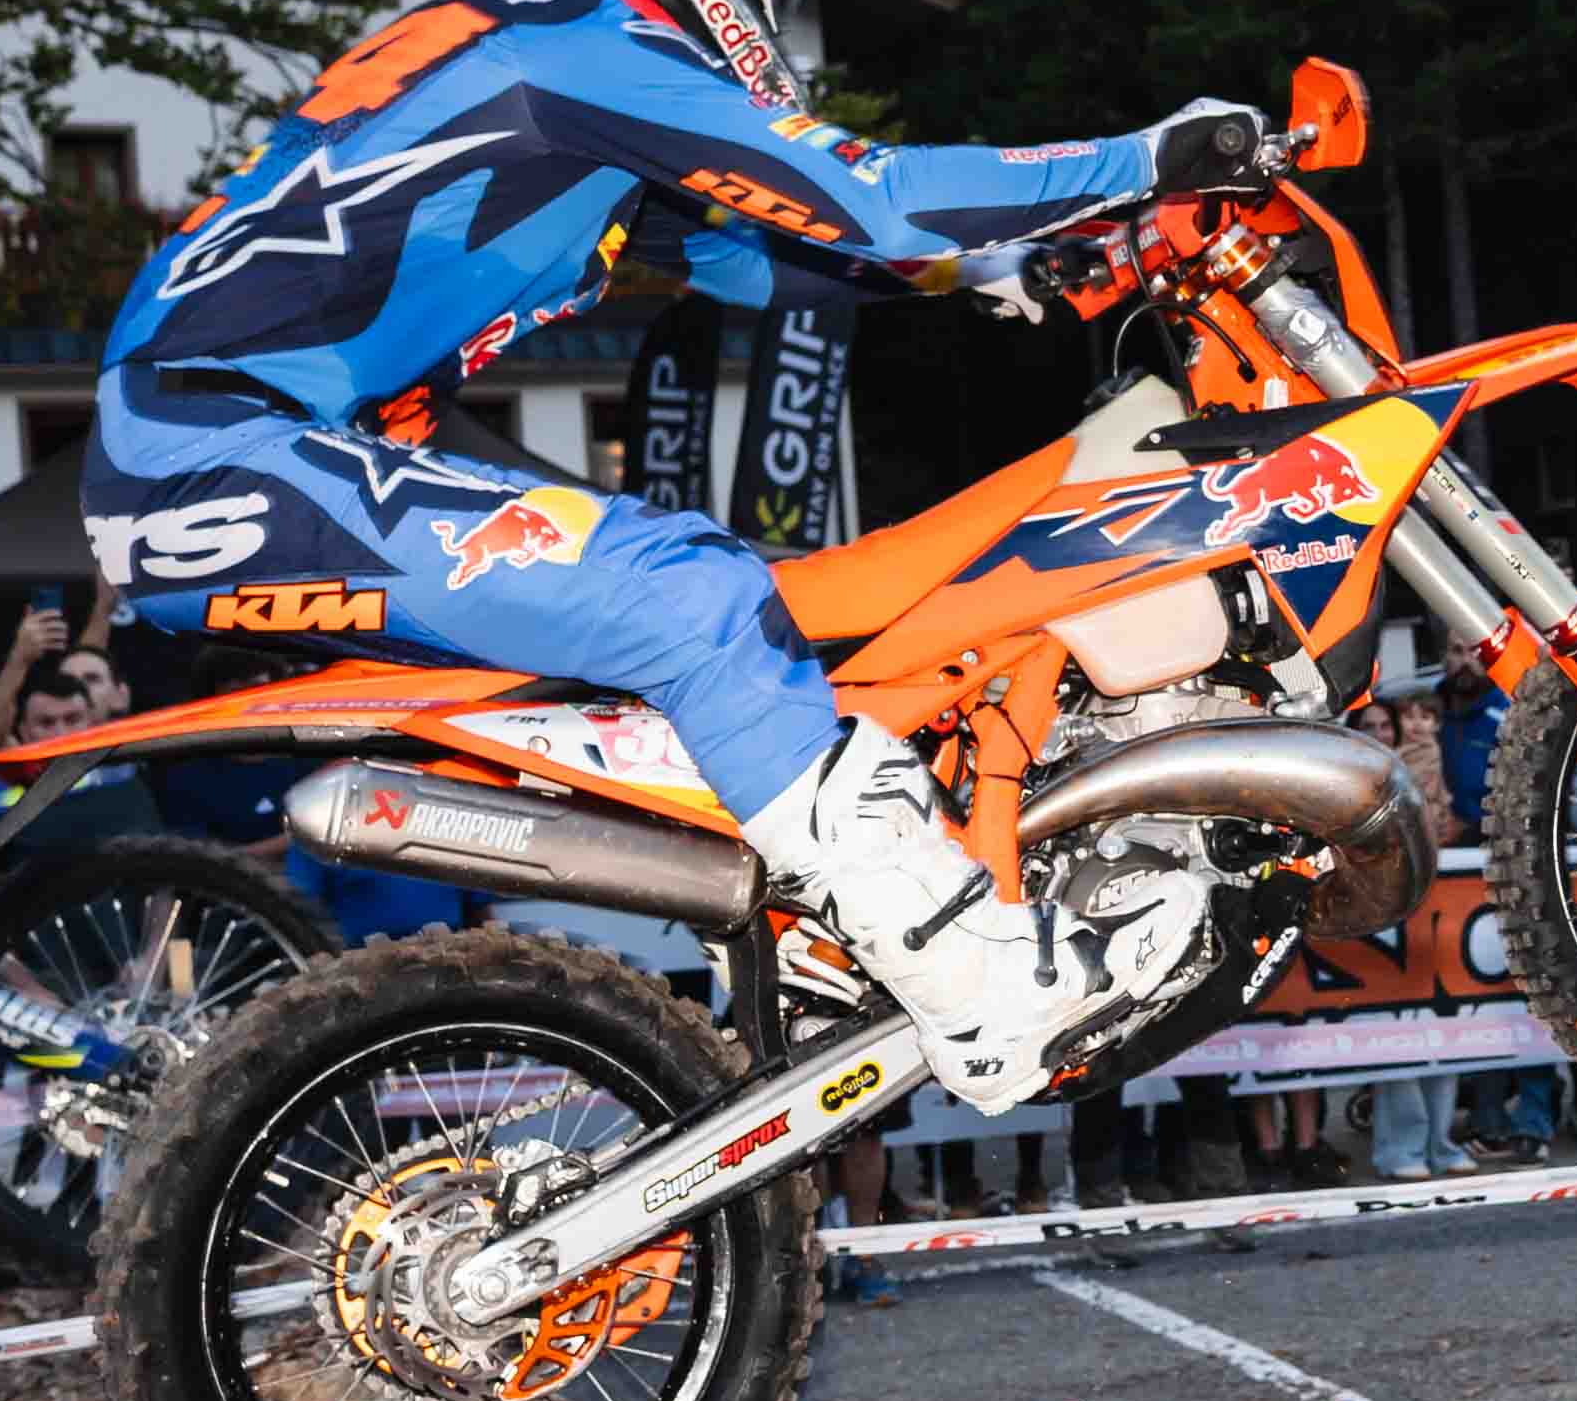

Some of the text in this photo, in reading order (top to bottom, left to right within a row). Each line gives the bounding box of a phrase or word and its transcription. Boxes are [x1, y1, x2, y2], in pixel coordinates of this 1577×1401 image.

[679, 167, 847, 244] KTM
[206, 579, 386, 632] KTM
[1097, 869, 1161, 911] KT
[644, 1107, 791, 1213] Supersprox
